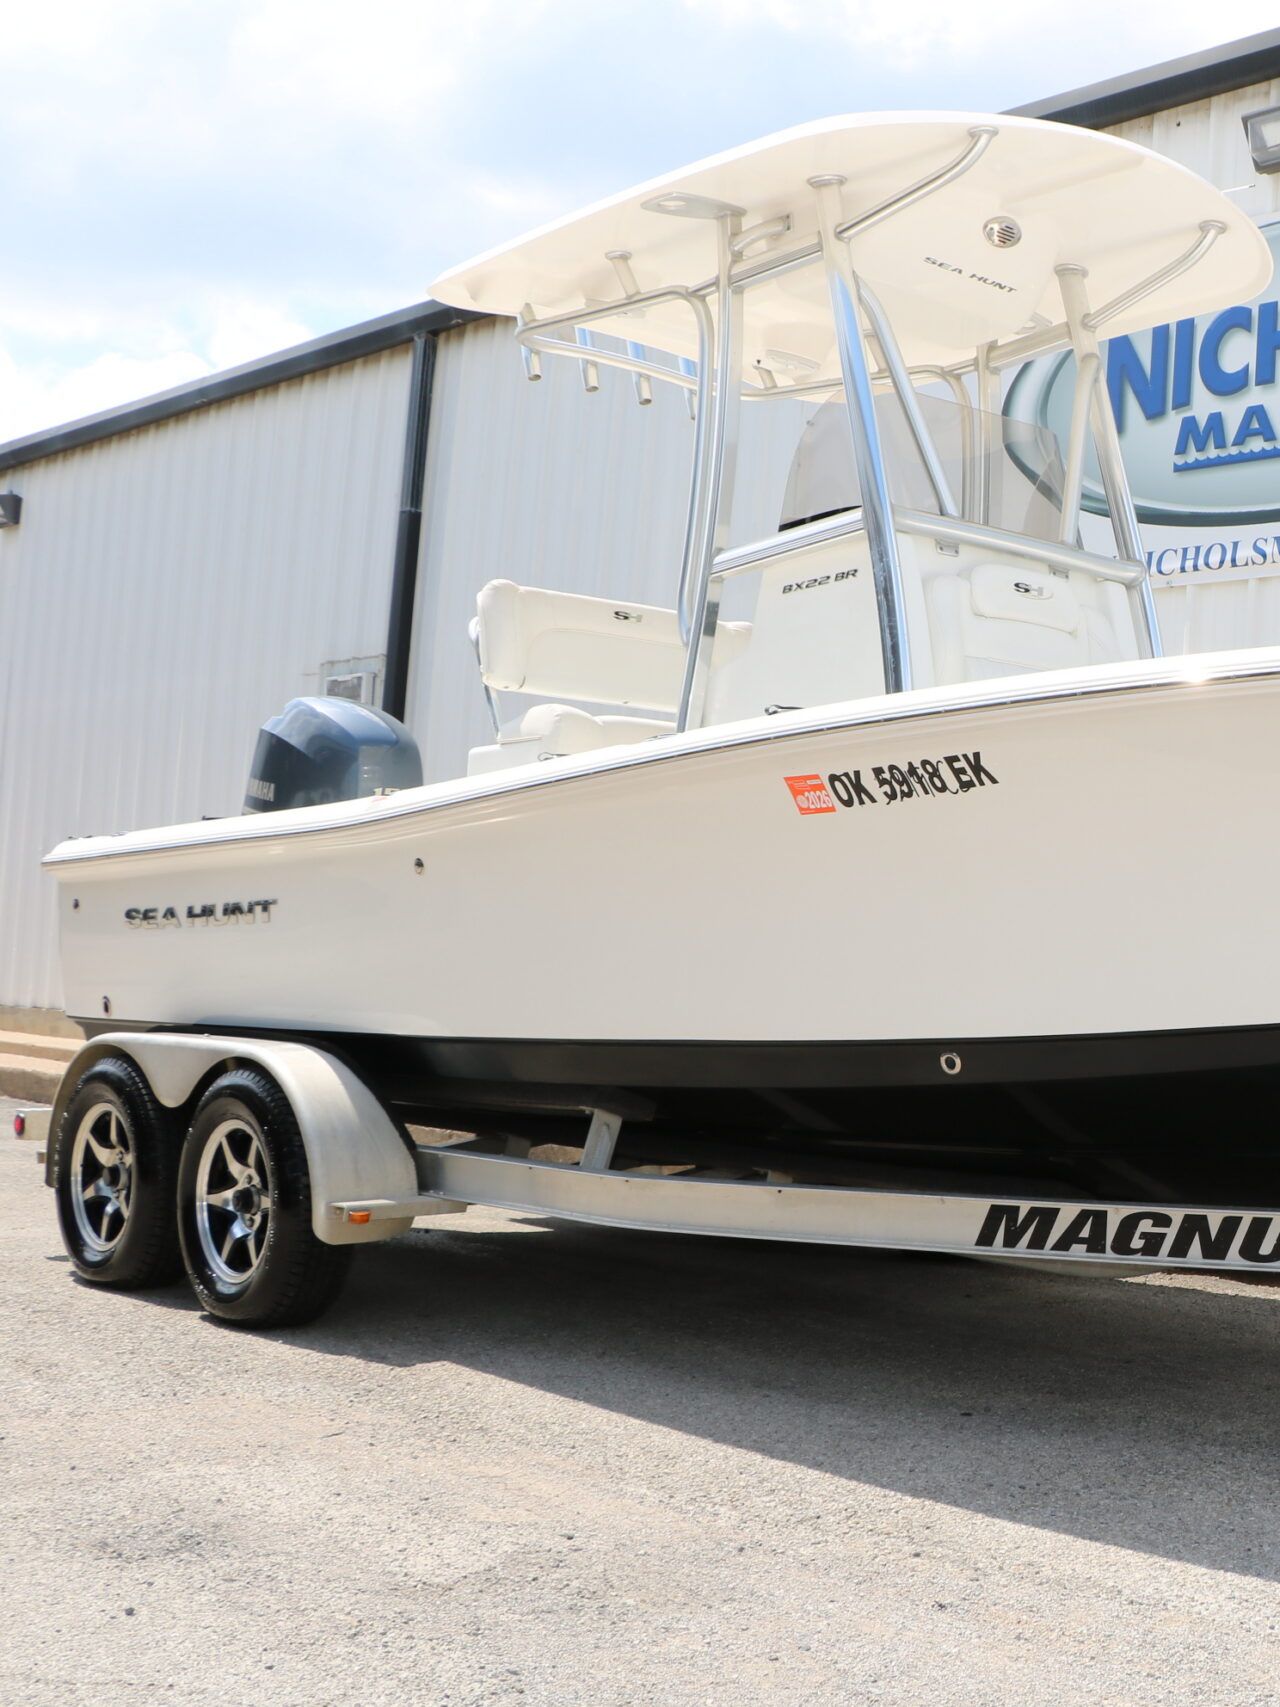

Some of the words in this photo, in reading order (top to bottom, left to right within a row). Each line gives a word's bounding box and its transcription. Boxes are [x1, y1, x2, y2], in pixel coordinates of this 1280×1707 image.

[923, 256, 962, 275] SEA
[969, 273, 1017, 293] HUNT
[782, 575, 831, 594] BX22
[834, 568, 858, 582] BR
[828, 769, 878, 808] OK
[872, 758, 949, 803] 5918
[943, 751, 999, 791] EK
[803, 790, 832, 809] 2026
[124, 906, 182, 930] SEA
[186, 898, 278, 928] HUNT
